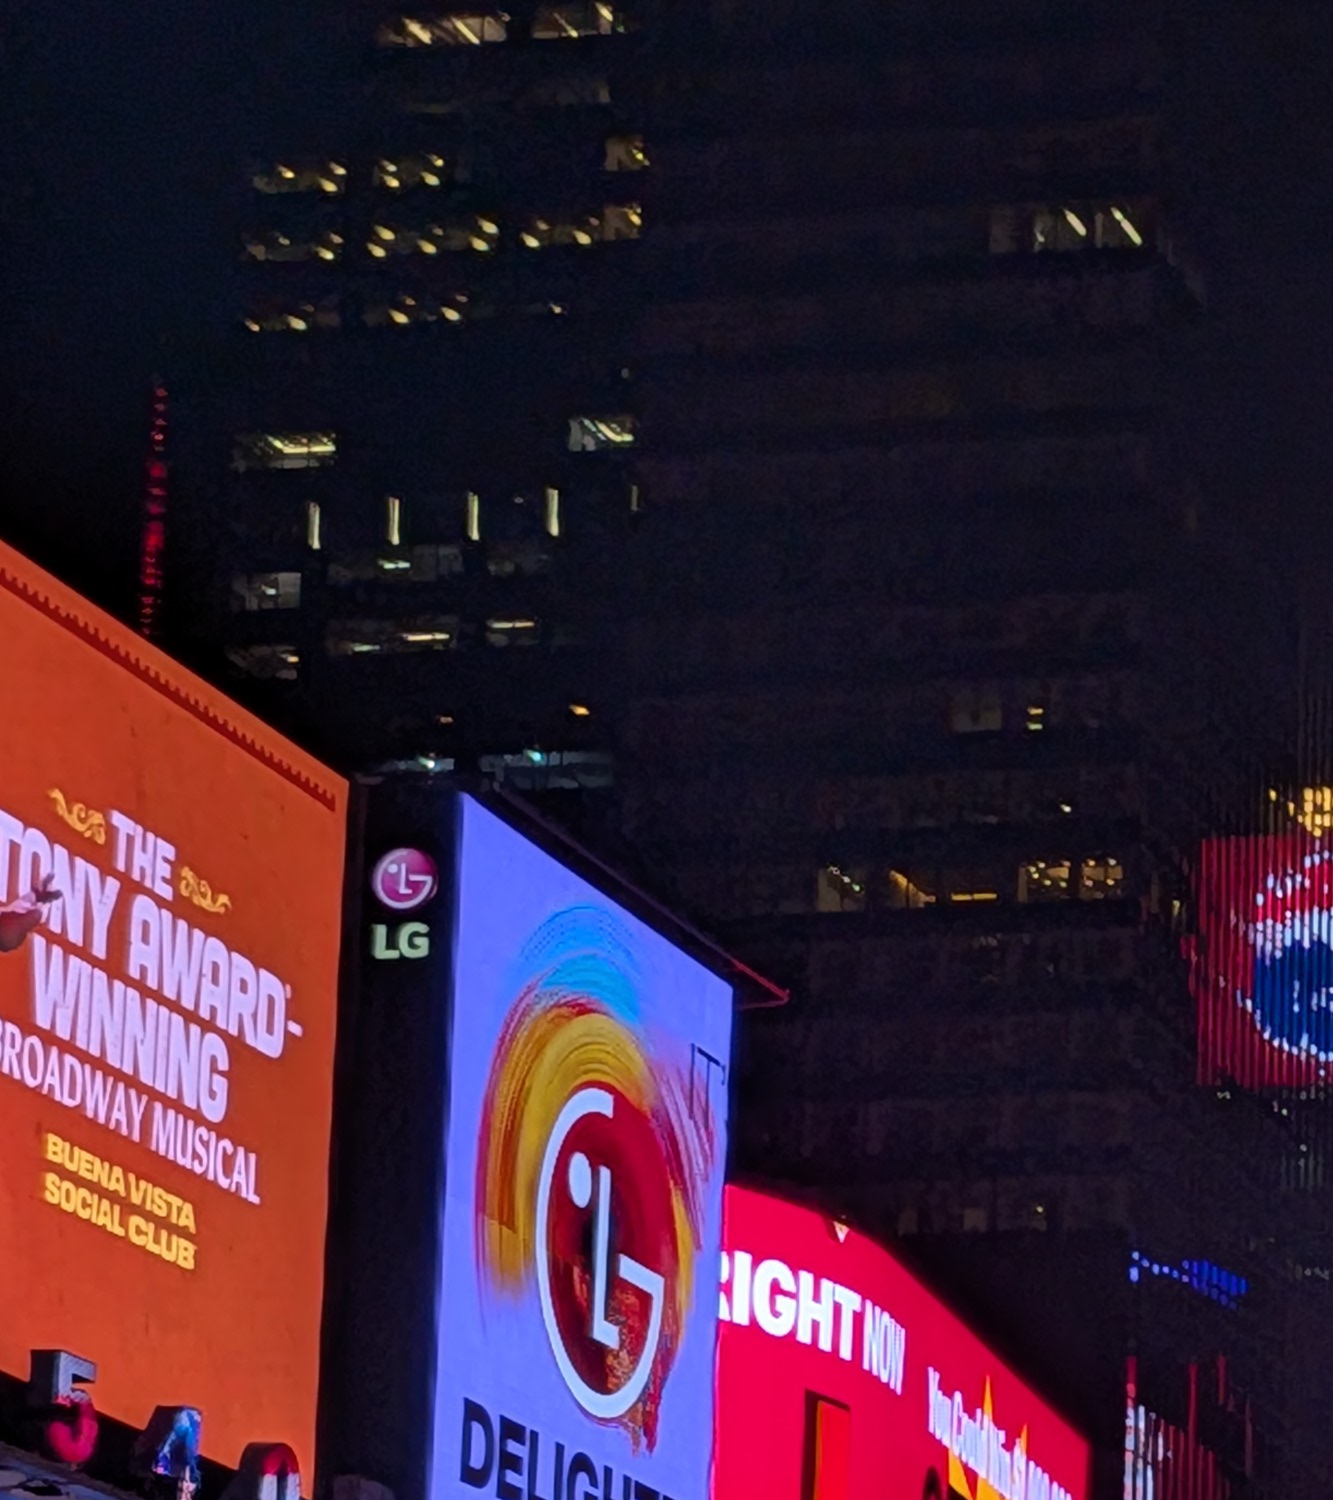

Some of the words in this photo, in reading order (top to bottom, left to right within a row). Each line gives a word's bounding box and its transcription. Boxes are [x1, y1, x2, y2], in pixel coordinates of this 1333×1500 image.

[111, 809, 175, 902] THE
[371, 924, 430, 959] LG
[30, 934, 230, 1123] WINNING
[47, 1132, 126, 1198] BUENA
[128, 1170, 196, 1235] VISTA
[151, 1105, 260, 1205] MUSICAL
[45, 1172, 125, 1239] SOCIAL
[128, 1214, 196, 1270] CLUB
[863, 1300, 905, 1395] NOW
